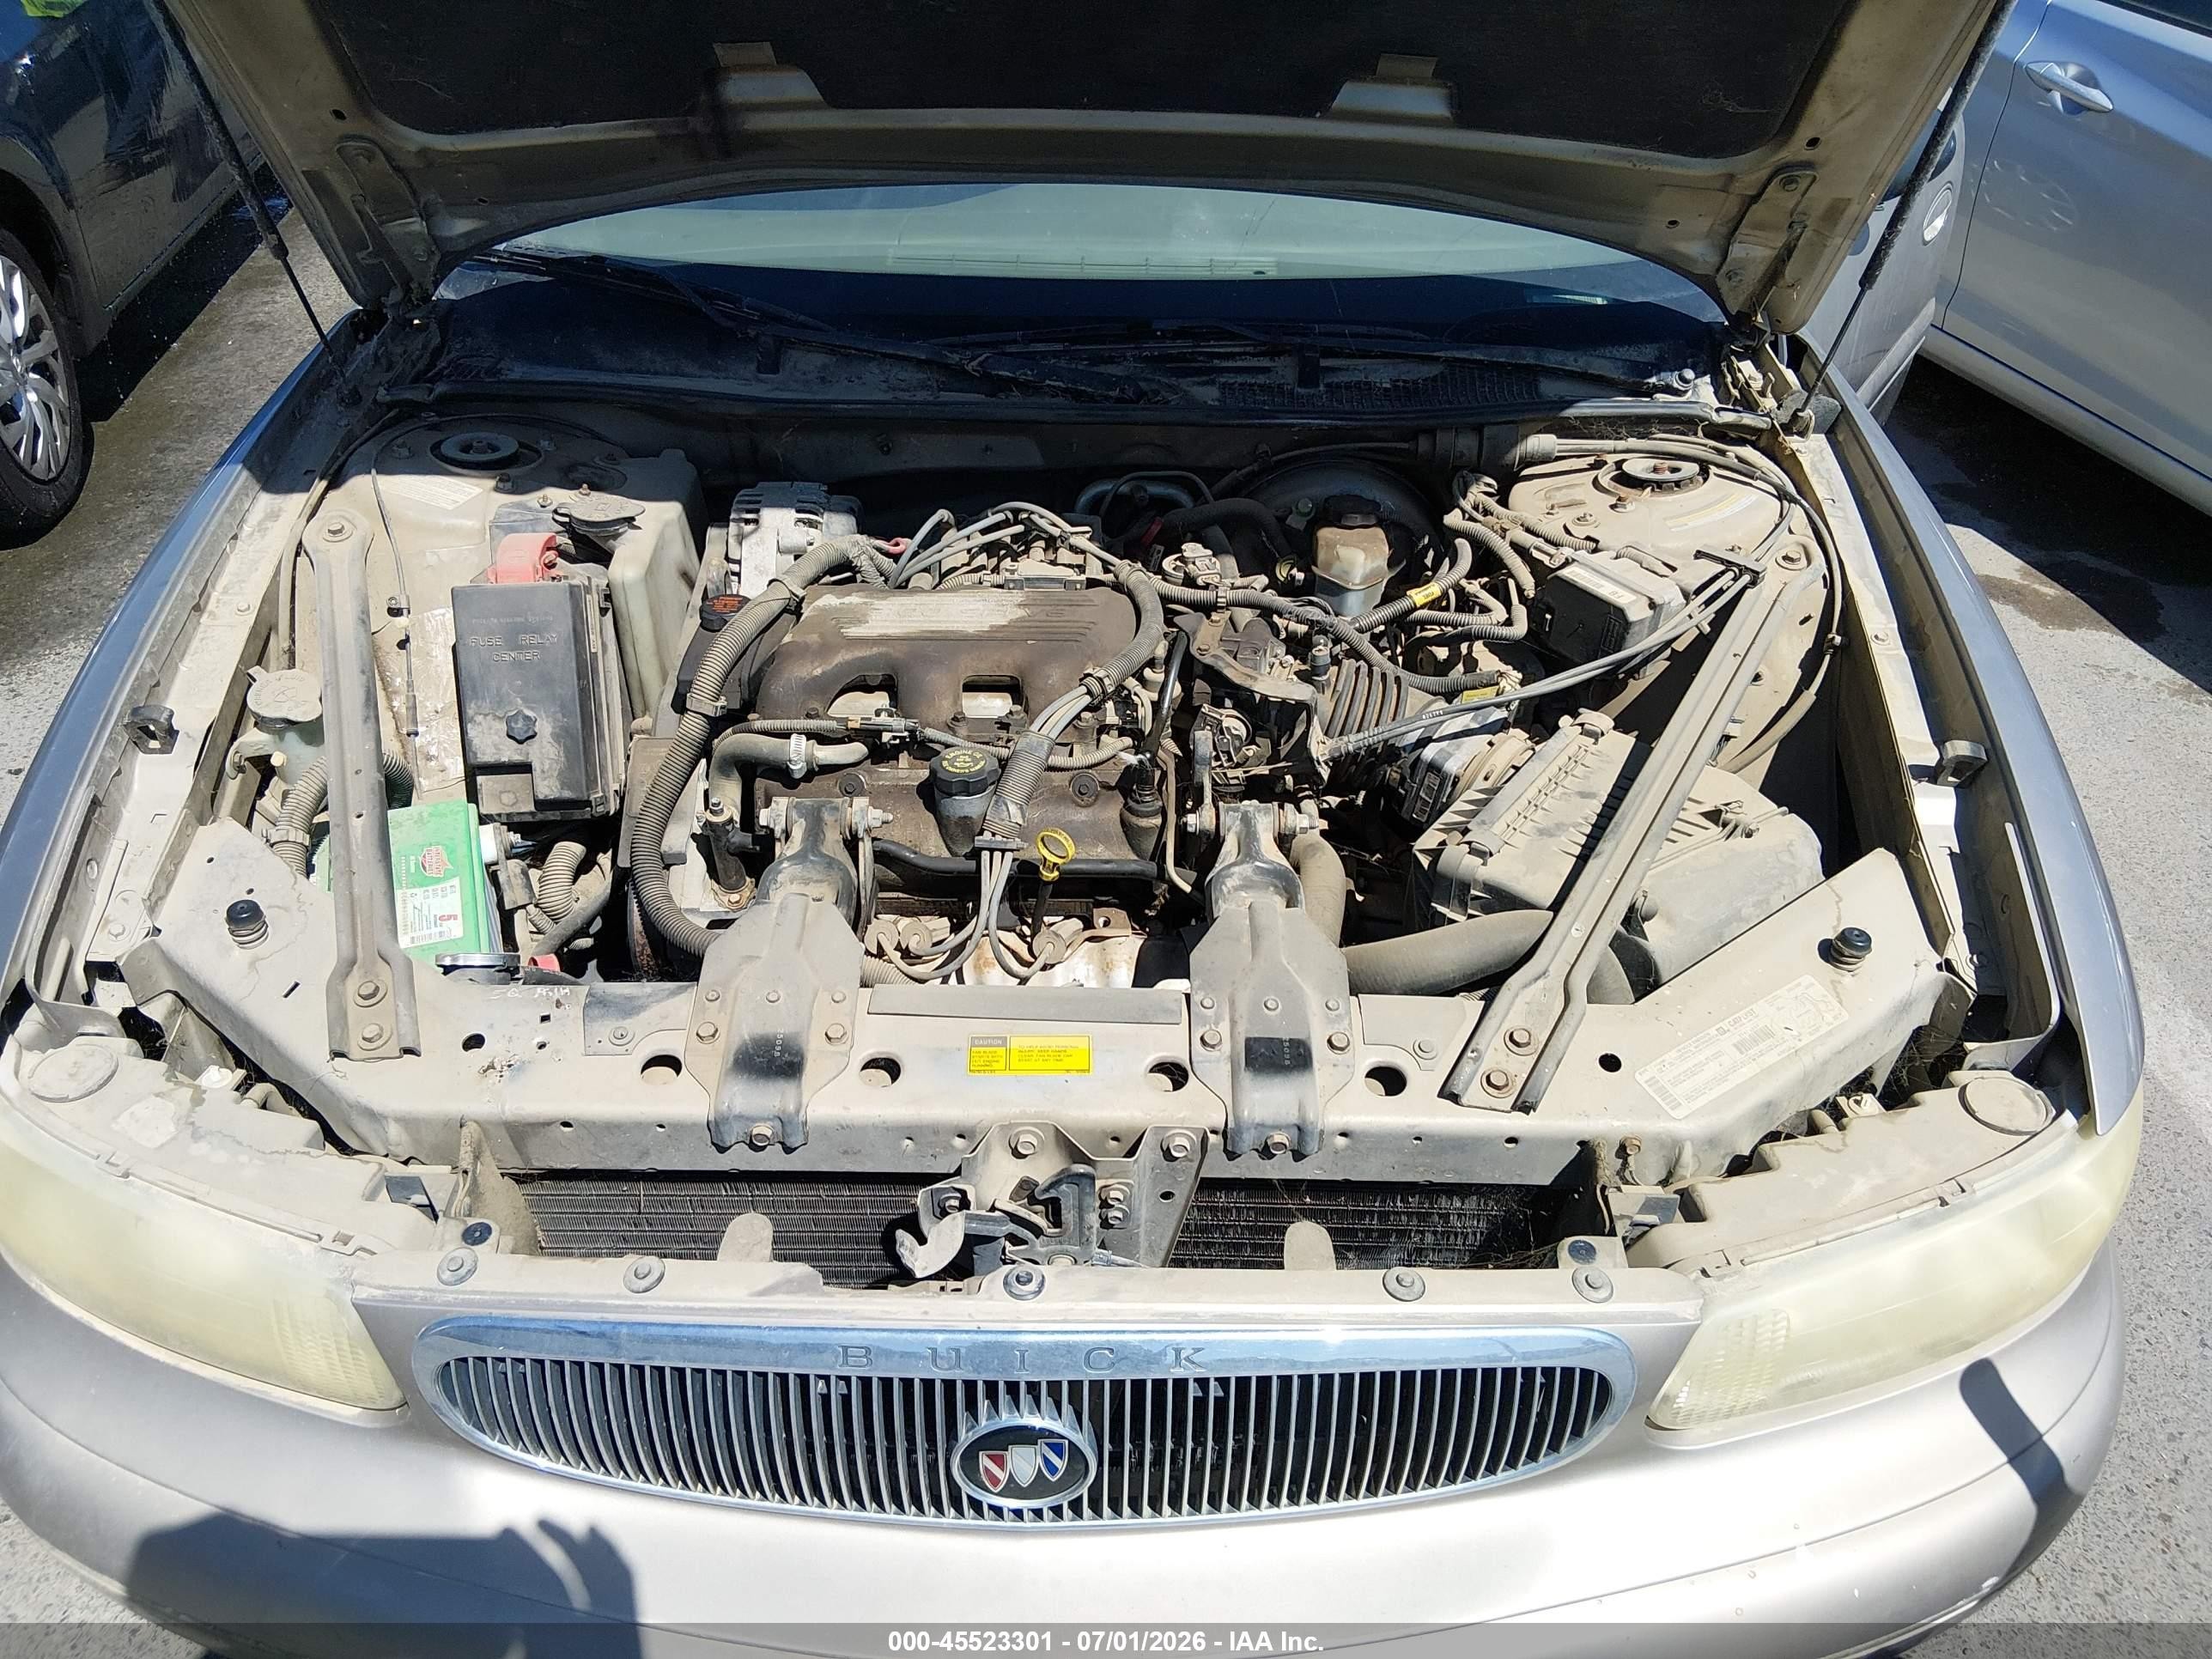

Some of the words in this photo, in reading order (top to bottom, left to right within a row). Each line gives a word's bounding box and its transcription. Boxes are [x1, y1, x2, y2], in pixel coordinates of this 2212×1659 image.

[470, 635, 502, 647] FUSE
[520, 633, 557, 646] RELAY
[492, 650, 541, 662] CENTER
[837, 1345, 1206, 1373] BUICK
